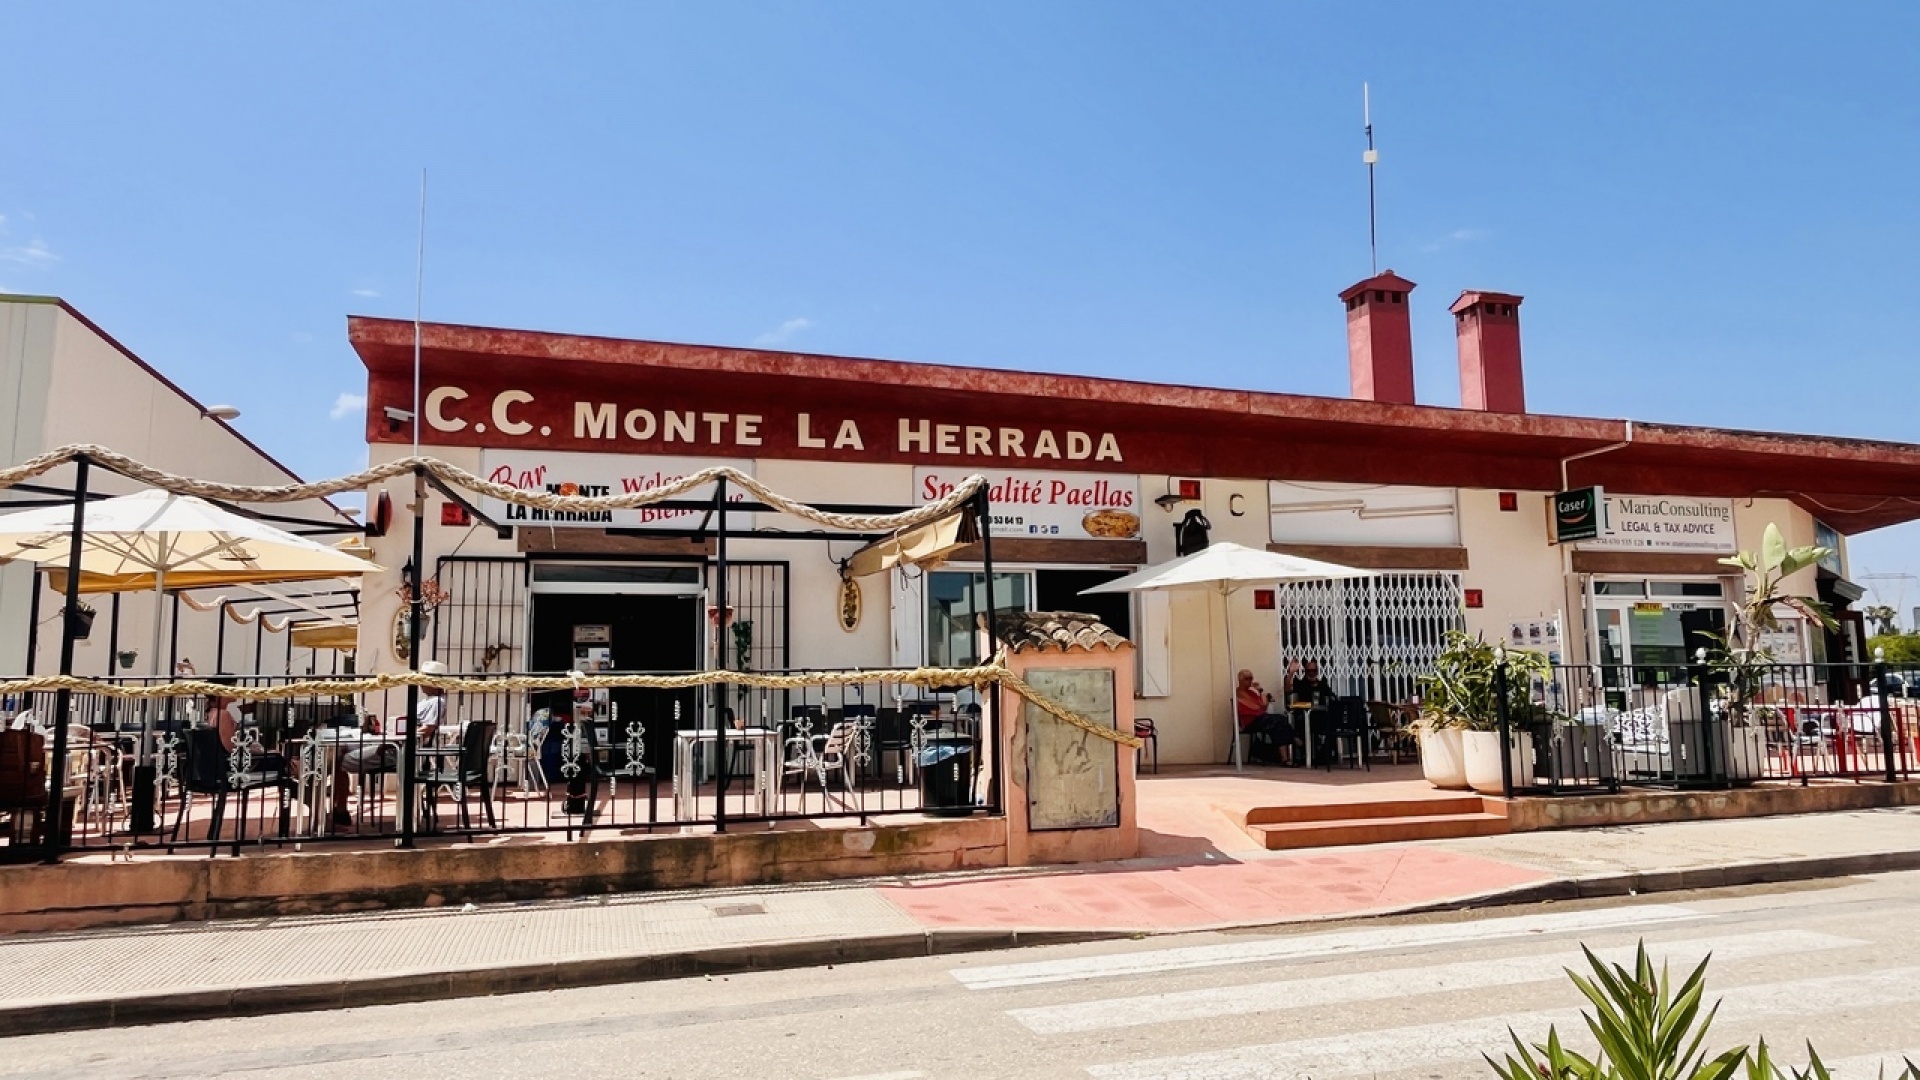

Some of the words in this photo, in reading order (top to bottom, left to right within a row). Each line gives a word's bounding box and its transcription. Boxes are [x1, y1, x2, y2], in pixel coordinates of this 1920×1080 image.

[425, 386, 551, 436] C.C.
[574, 401, 763, 446] MONTE
[798, 413, 864, 451] LA
[898, 418, 1123, 462] HERRADA
[488, 464, 547, 490] Bar
[1048, 480, 1133, 507] Paellas
[1229, 493, 1245, 516] C
[507, 503, 527, 520] LA
[1558, 500, 1586, 513] Caser
[1619, 499, 1730, 522] MariaConsulting
[1621, 521, 1651, 532] LEGAL
[1654, 522, 1661, 533] &
[1663, 522, 1680, 533] TAX
[1682, 524, 1715, 535] ADVICE
